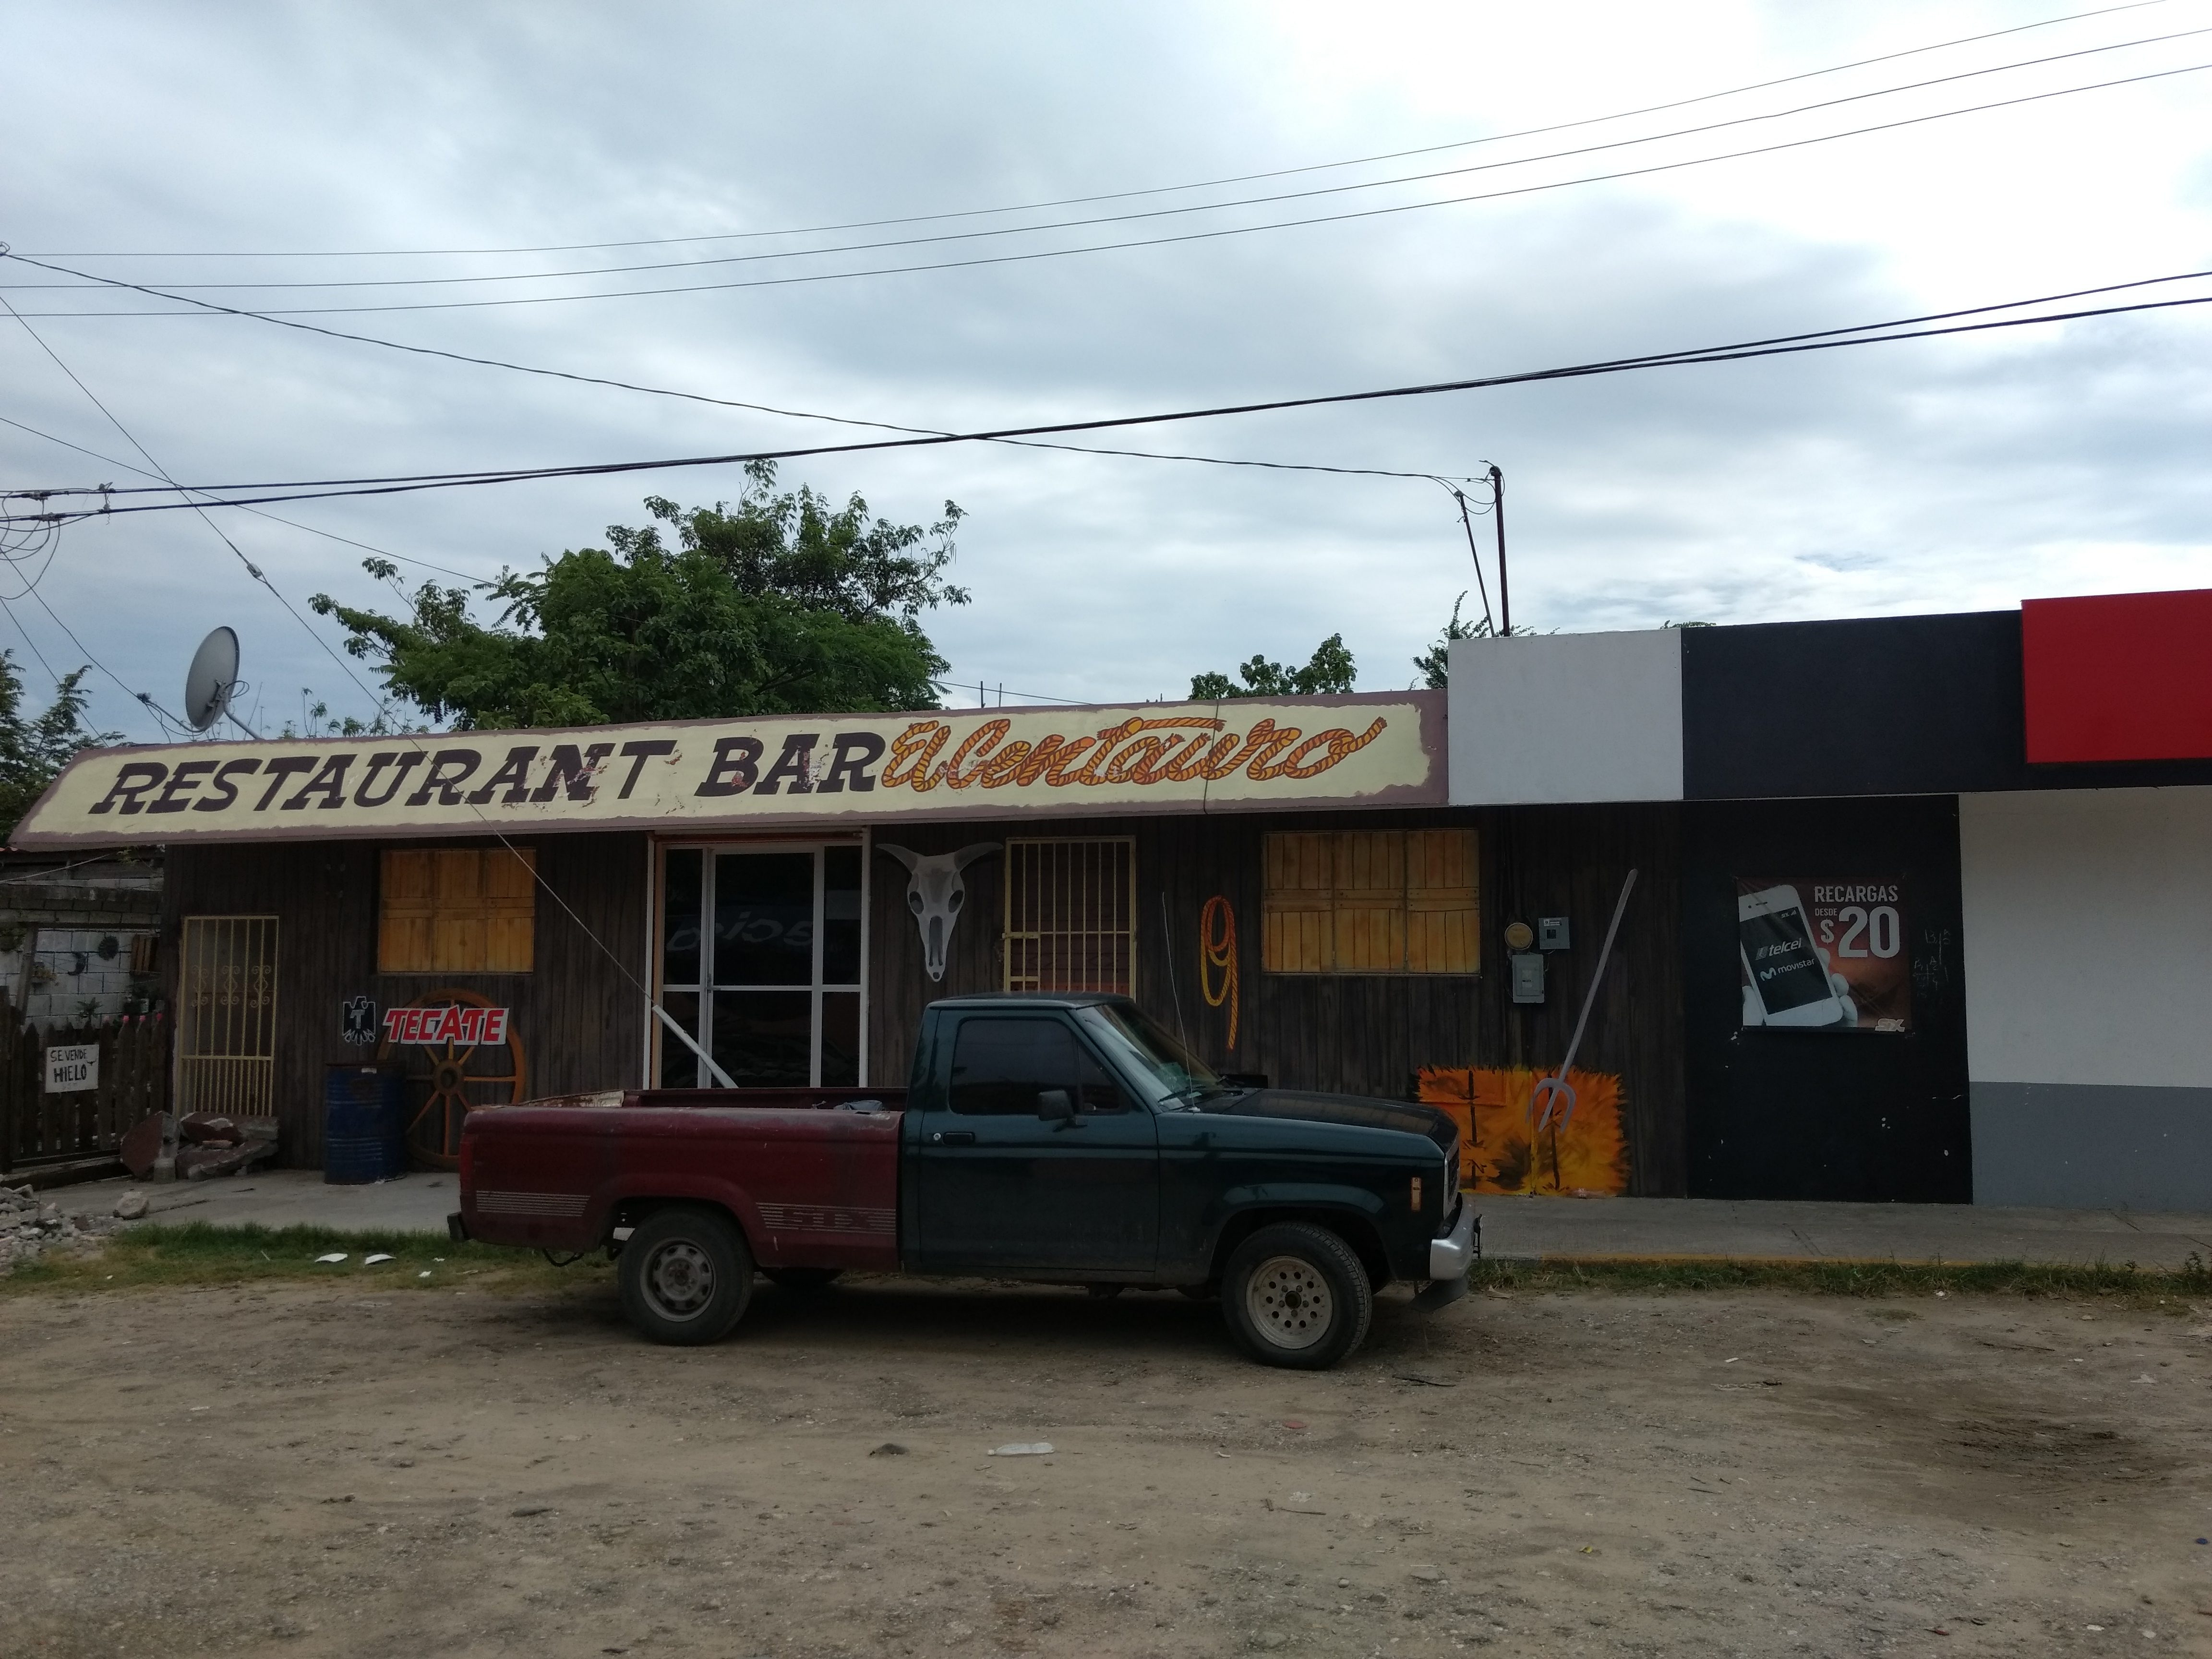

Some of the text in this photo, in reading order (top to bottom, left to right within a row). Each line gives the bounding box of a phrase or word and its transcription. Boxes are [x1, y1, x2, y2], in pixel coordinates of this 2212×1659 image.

[87, 740, 678, 815] RESTAURANT
[694, 732, 885, 796] BAR
[1814, 885, 1899, 902] RECARGAS
[1815, 907, 1838, 916] DESDE
[1767, 937, 1802, 957] telcel
[1777, 958, 1815, 974] movistar
[385, 1006, 505, 1042] TECATE
[50, 1050, 63, 1062] SE
[54, 1064, 87, 1083] HIELO
